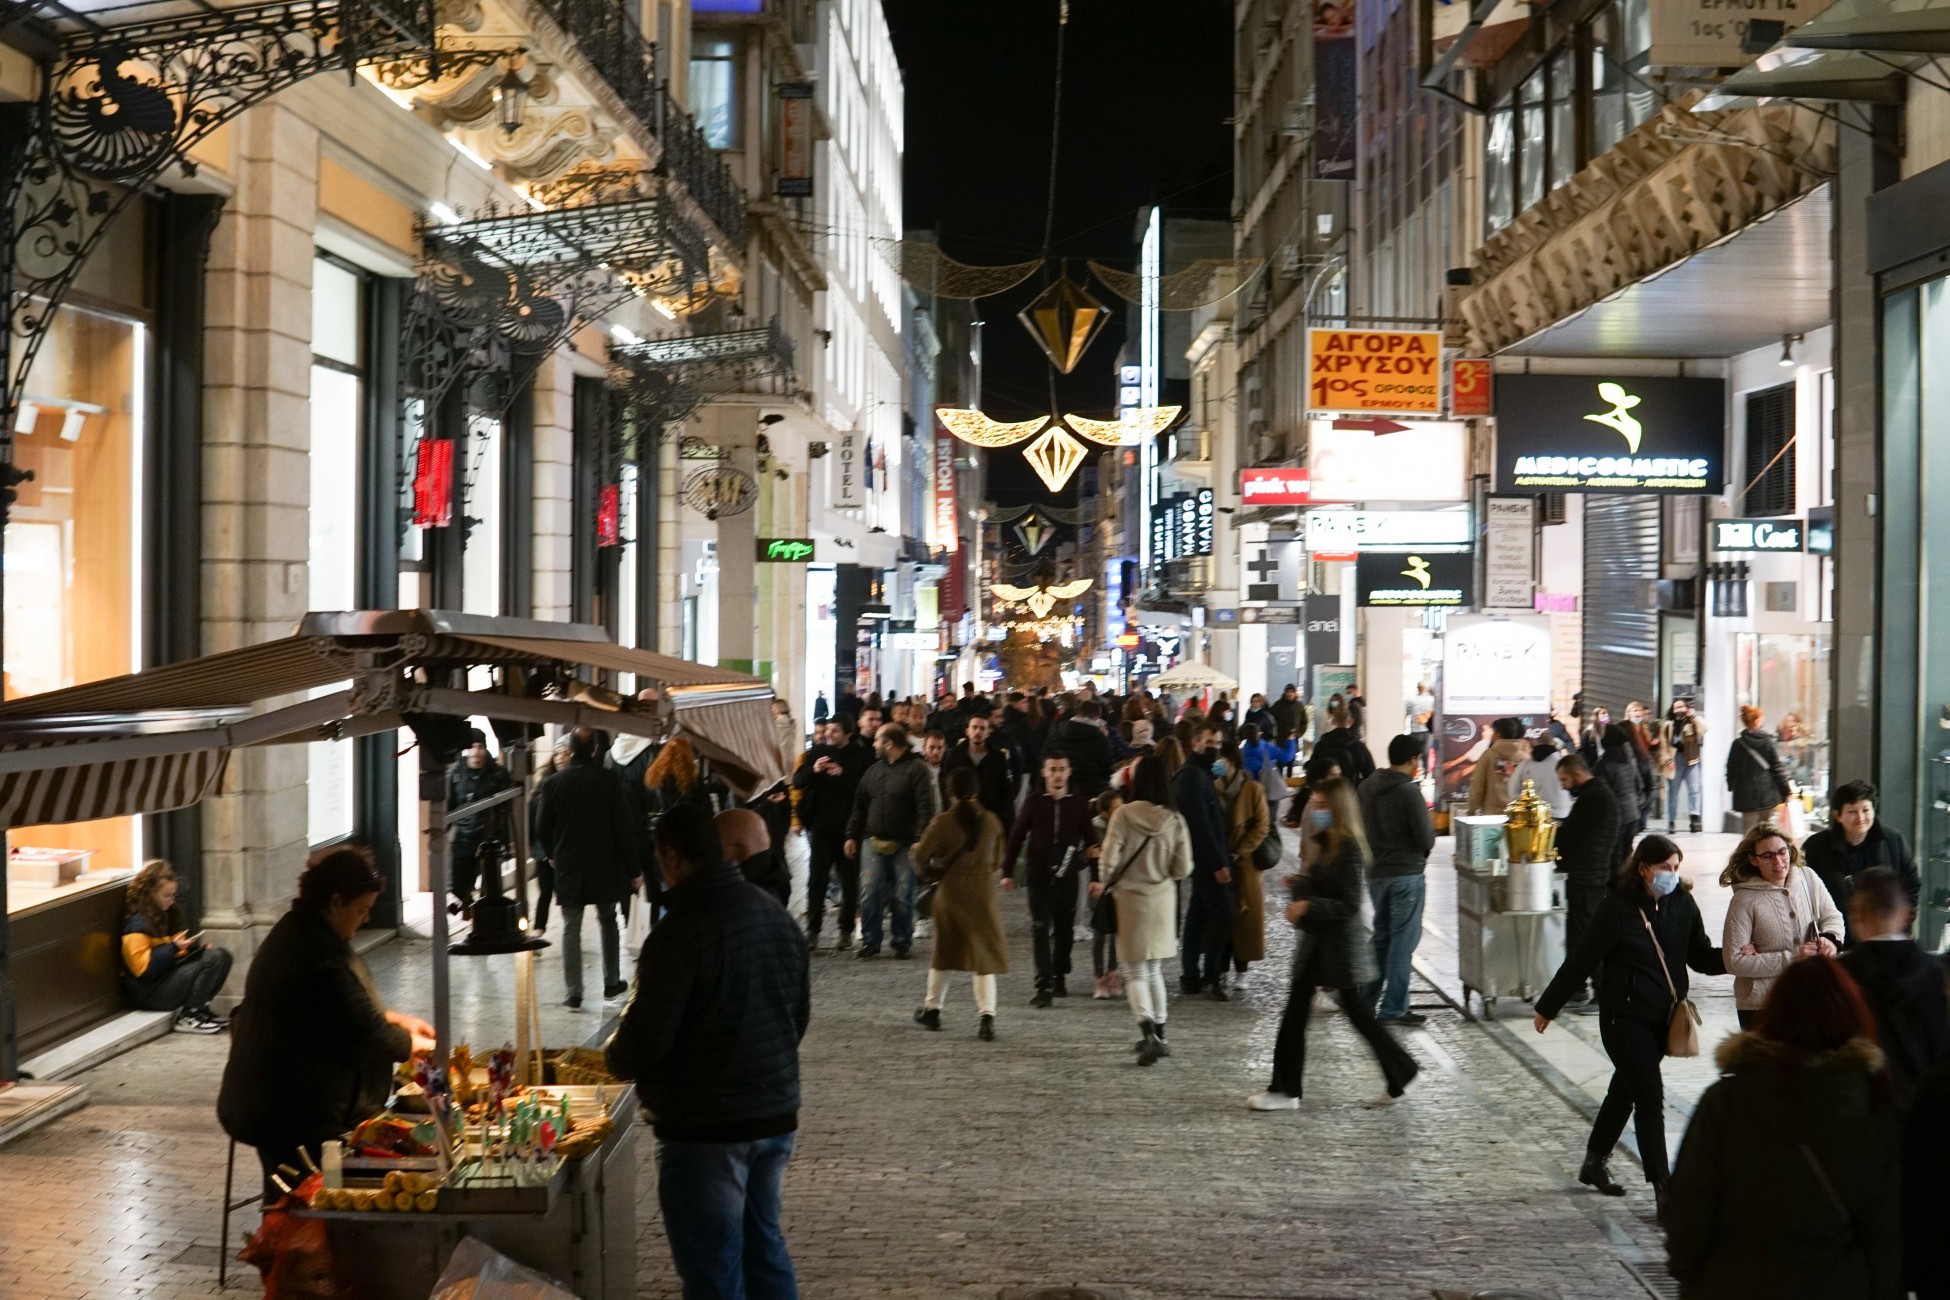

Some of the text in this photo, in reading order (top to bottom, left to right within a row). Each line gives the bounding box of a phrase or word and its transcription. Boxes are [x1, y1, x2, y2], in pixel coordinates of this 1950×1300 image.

[1325, 334, 1426, 354] ΑΓΟΡΑ
[1313, 354, 1436, 375] ΧΡΥΣΟΥ
[1312, 377, 1437, 406] 1ος ΟΡΟΦΟΣ
[1360, 400, 1436, 409] ΕΡΜΟΥ 14
[841, 435, 854, 499] HOTEL
[937, 438, 954, 491] HOUSE
[1514, 456, 1708, 477] MEDICOSMETIC
[1244, 476, 1286, 497] pink
[937, 498, 954, 545] APIN
[1182, 499, 1196, 556] MANGO
[1198, 490, 1213, 553] MANGO
